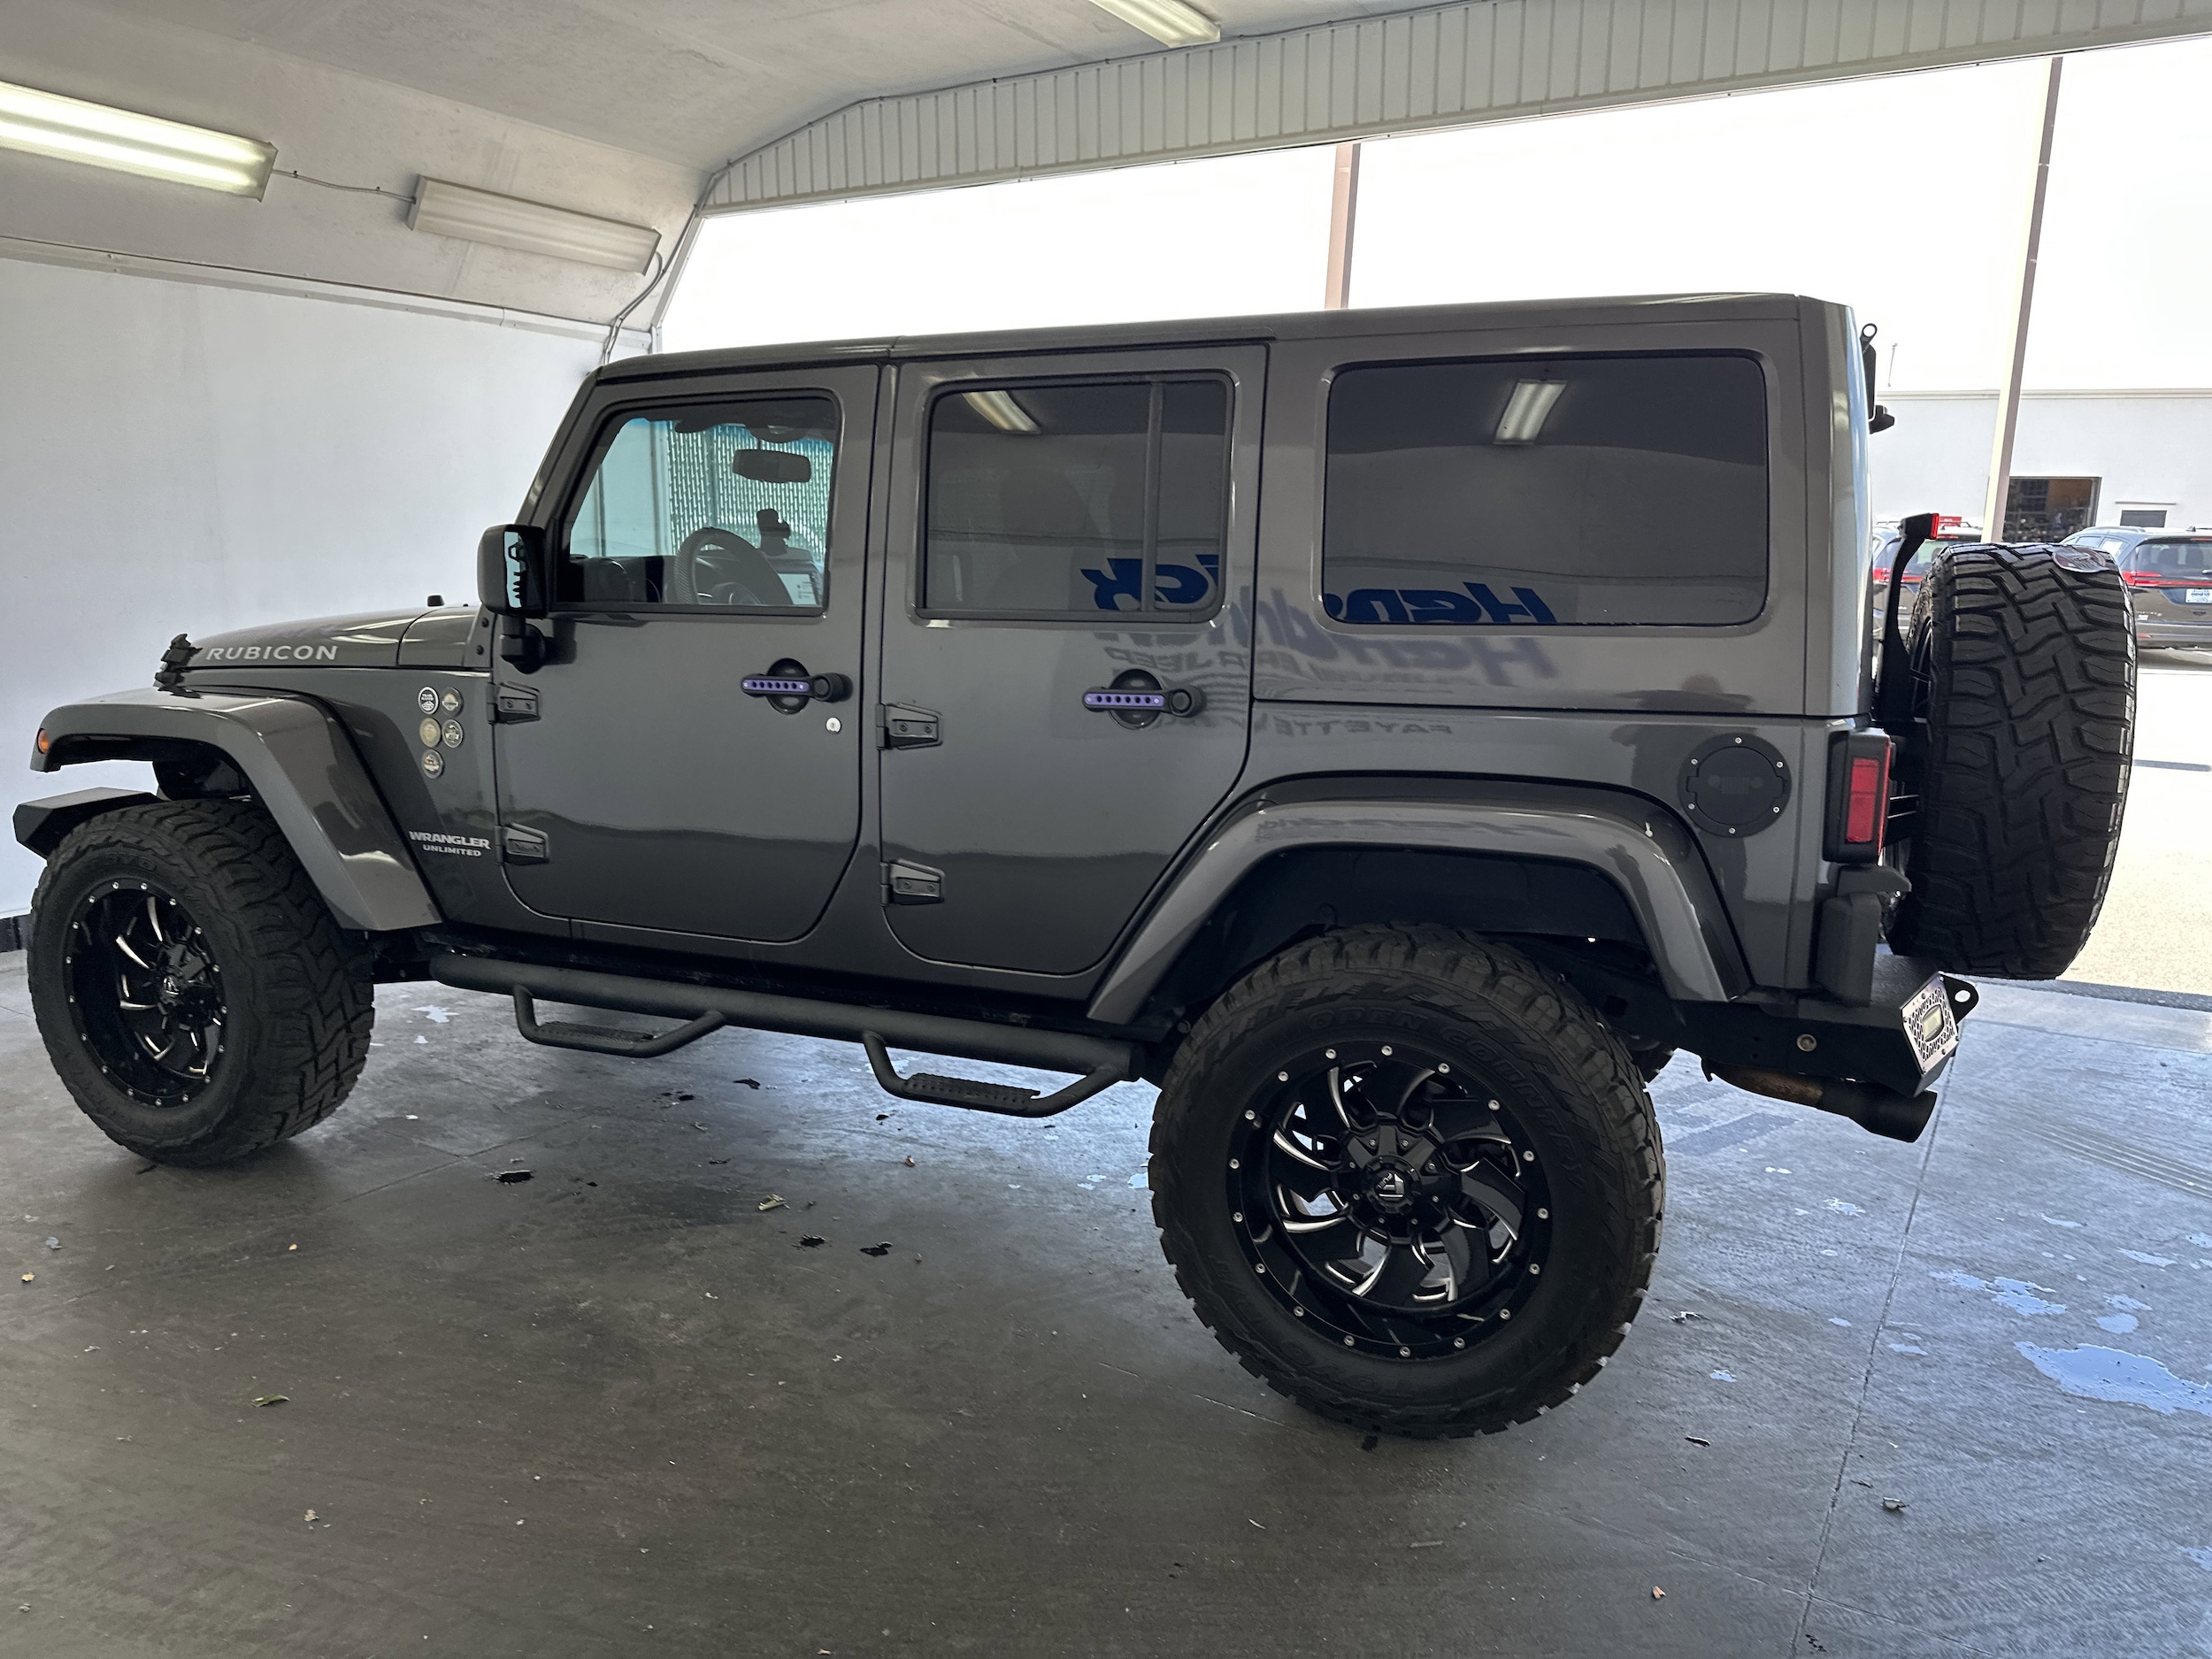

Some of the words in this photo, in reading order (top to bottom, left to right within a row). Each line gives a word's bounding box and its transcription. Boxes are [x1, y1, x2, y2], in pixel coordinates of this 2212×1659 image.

[205, 645, 339, 661] RUBICON
[408, 830, 492, 850] WRANGLER
[422, 844, 482, 857] UNLIMITED
[1310, 1007, 1424, 1033] OPEN
